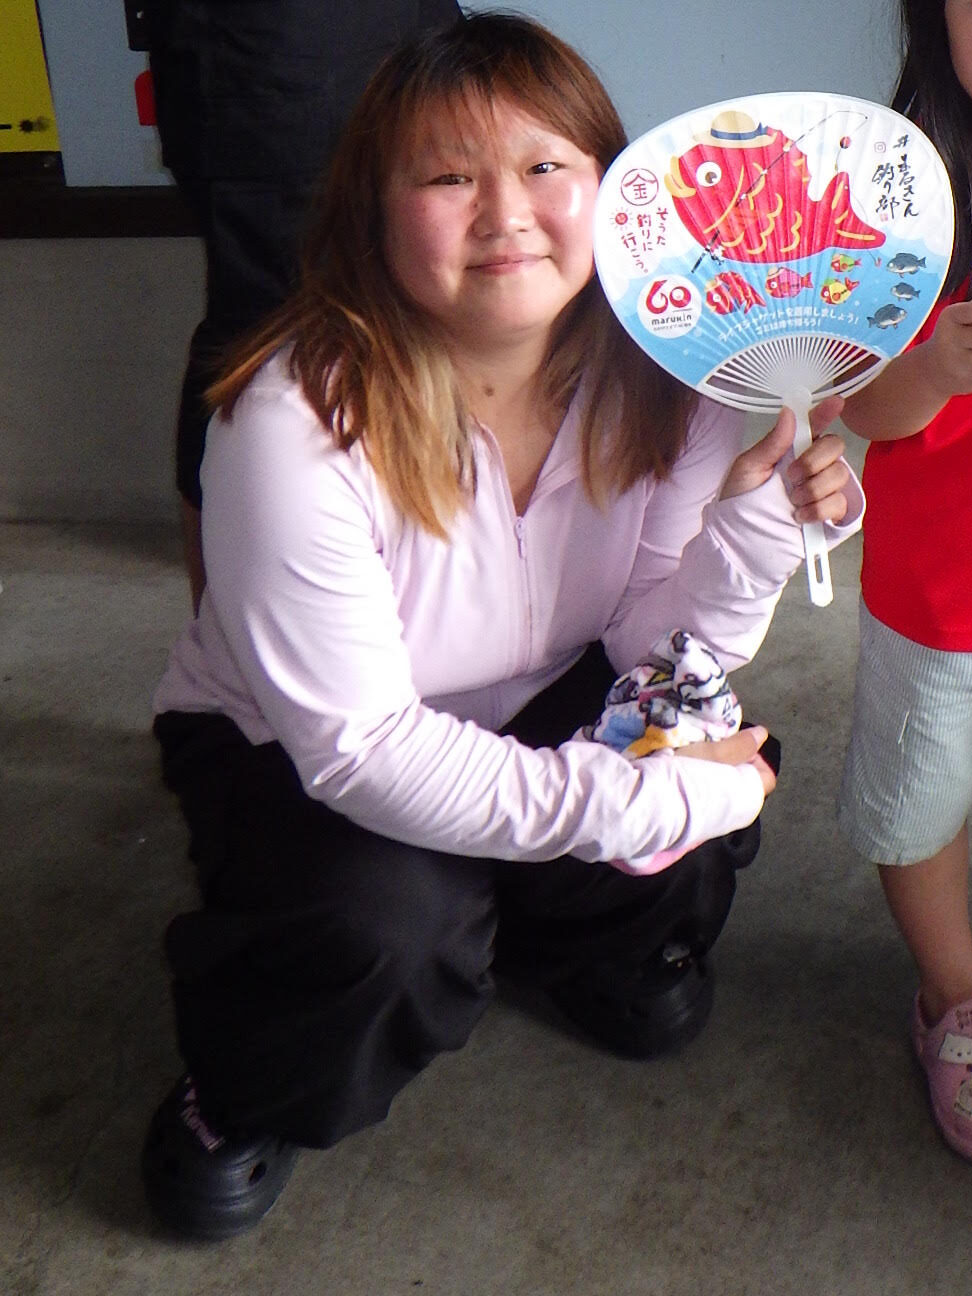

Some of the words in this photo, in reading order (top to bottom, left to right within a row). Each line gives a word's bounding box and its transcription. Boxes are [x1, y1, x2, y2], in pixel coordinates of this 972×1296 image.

[621, 170, 658, 203] 金
[637, 213, 653, 252] 釣りに
[646, 279, 692, 315] 60
